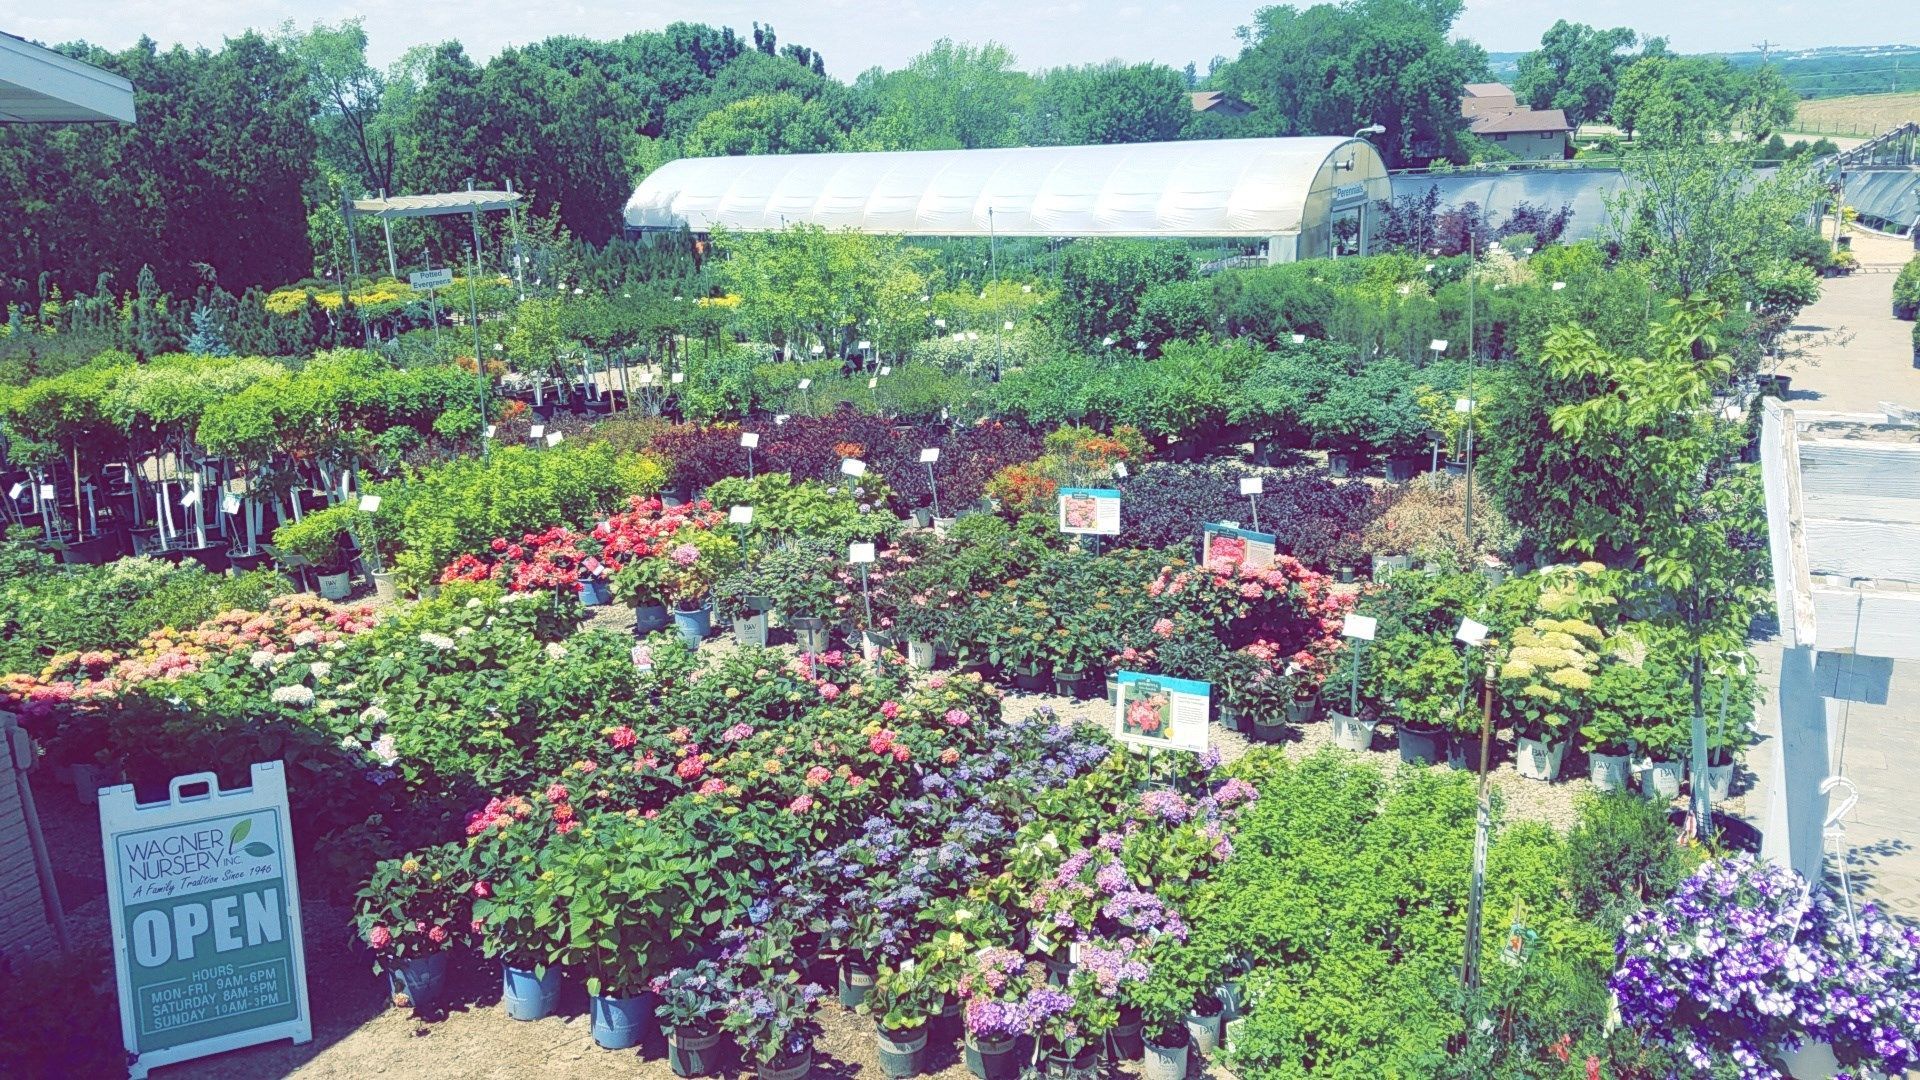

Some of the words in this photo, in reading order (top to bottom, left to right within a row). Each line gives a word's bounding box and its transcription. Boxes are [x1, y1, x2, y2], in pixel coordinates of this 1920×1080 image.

[1337, 183, 1364, 198] Perennials
[413, 279, 451, 289] Evergreens
[420, 270, 442, 279] Potted
[126, 829, 223, 862] WAGNER
[129, 849, 224, 883] NURSERY
[133, 885, 142, 898] A
[146, 880, 175, 895] Family
[181, 875, 218, 890] Tradition
[222, 869, 245, 881] Since
[249, 865, 272, 876] 1946
[132, 887, 282, 967] OPEN
[151, 984, 208, 1004] MON-FRI
[216, 967, 277, 990] 9AM-6PM
[192, 964, 234, 982] HOURS
[152, 994, 216, 1017] SATURDAY
[223, 980, 278, 1001] 8AM-5PM
[154, 1009, 206, 1030] SUNDAY
[214, 992, 279, 1016] 10AM-3PM
